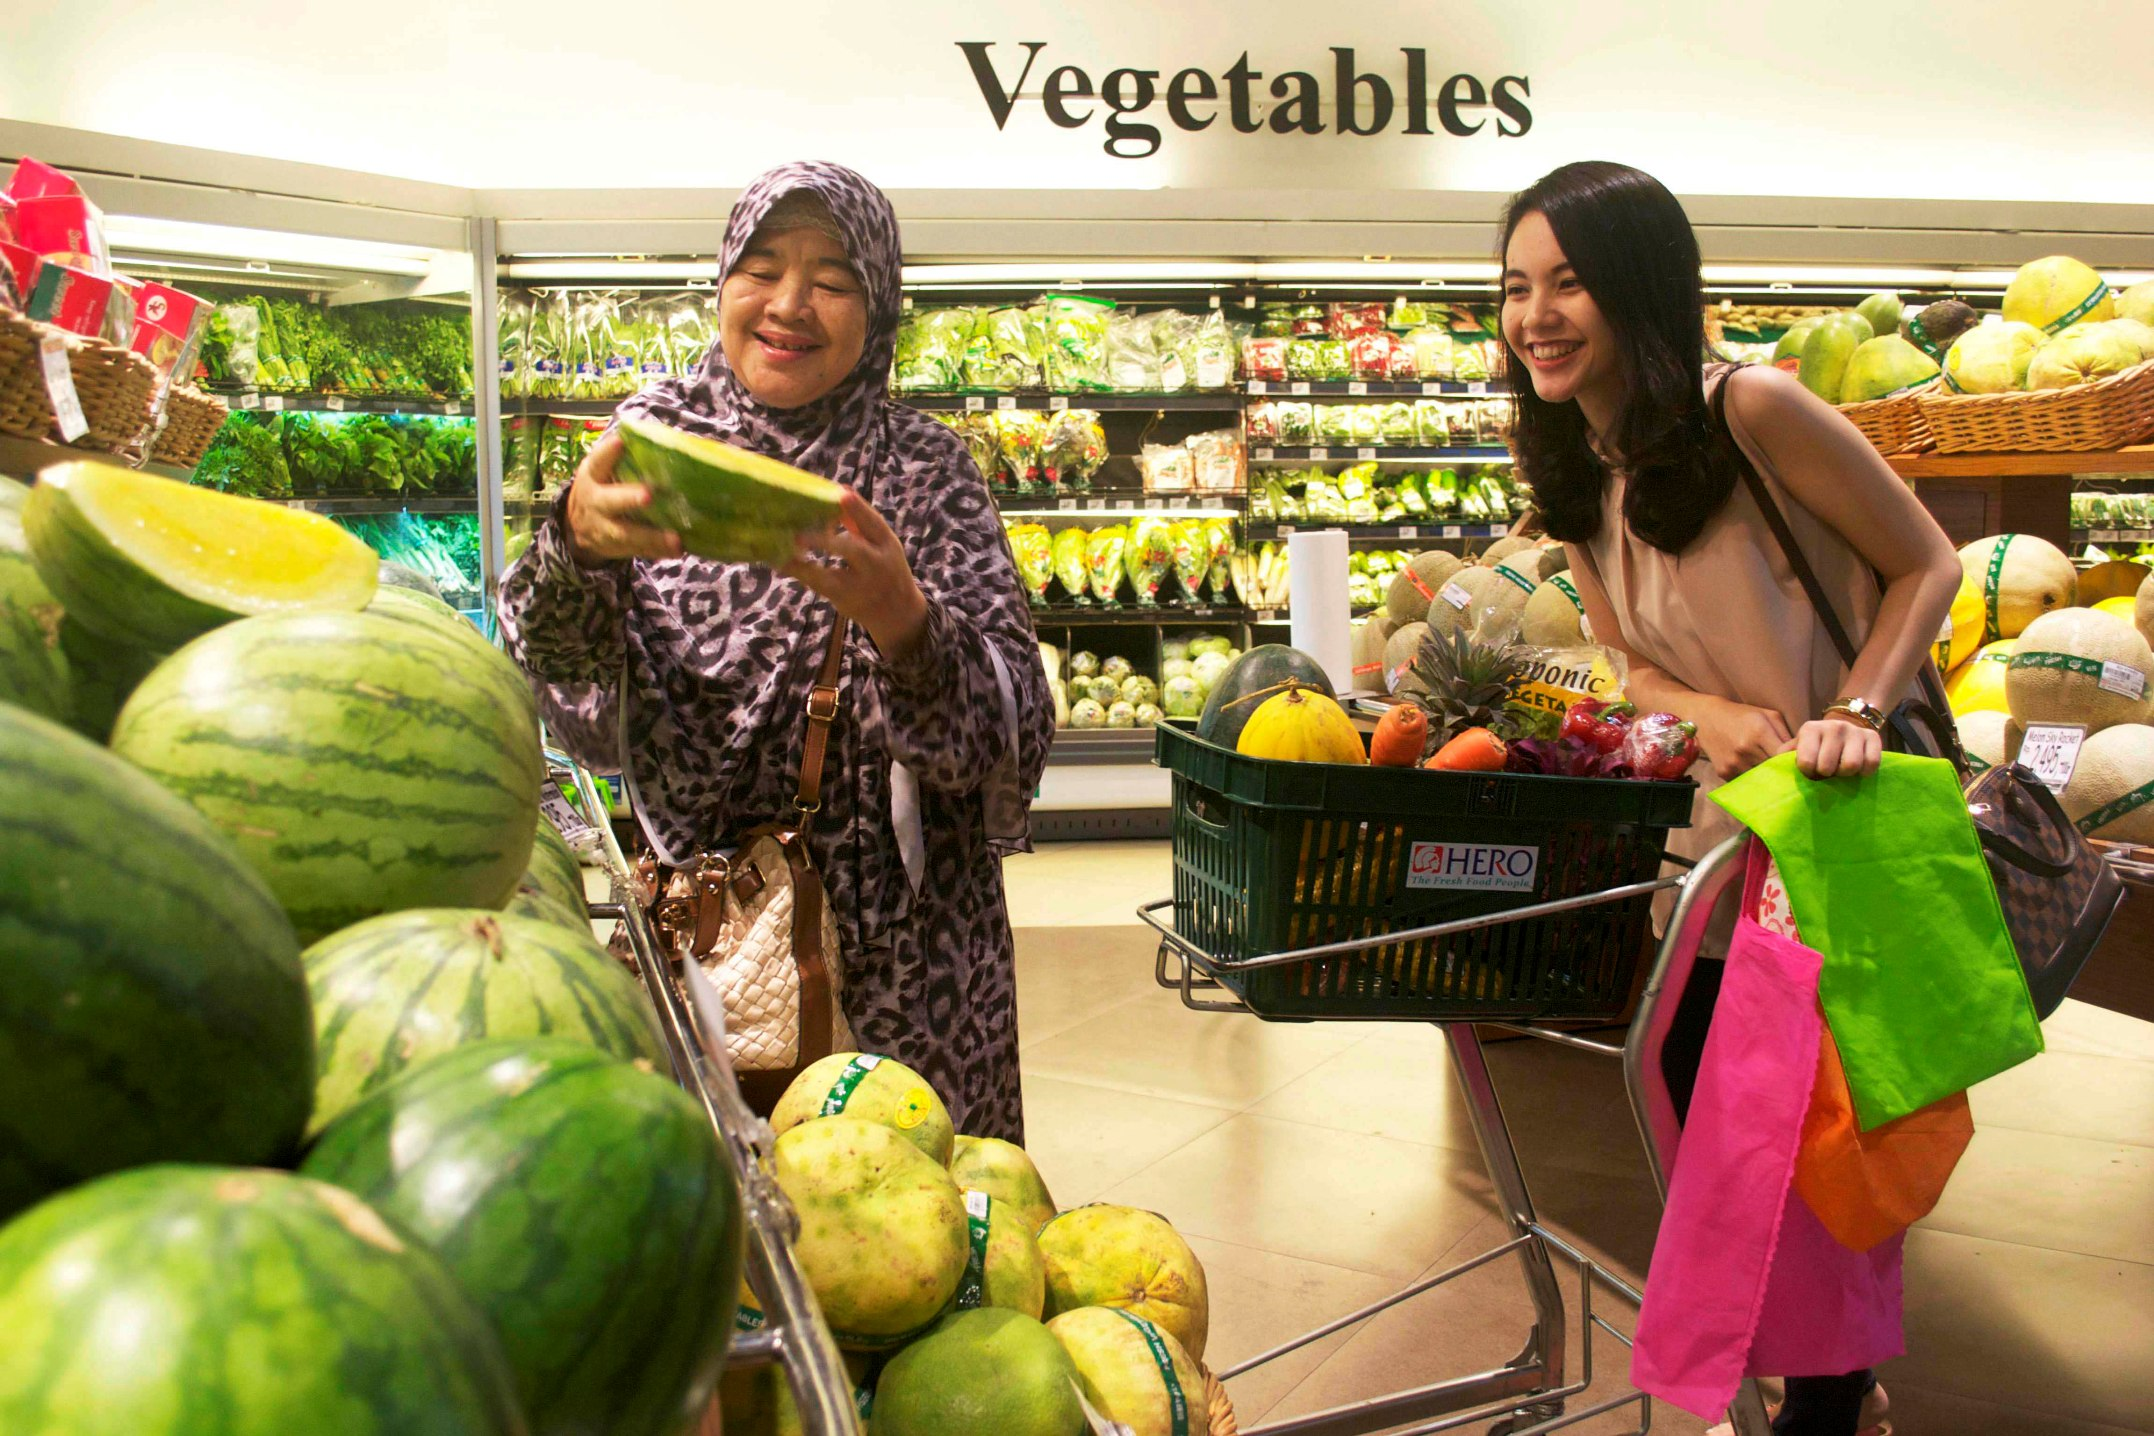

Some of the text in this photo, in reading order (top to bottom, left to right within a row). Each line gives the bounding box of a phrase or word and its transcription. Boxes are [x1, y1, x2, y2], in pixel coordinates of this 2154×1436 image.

[954, 41, 1533, 159] Vegetables
[1513, 660, 1606, 693] oponic
[1511, 688, 1567, 712] EGETA
[1445, 848, 1533, 876] HERO
[1412, 876, 1530, 888] The Fresh Food People
